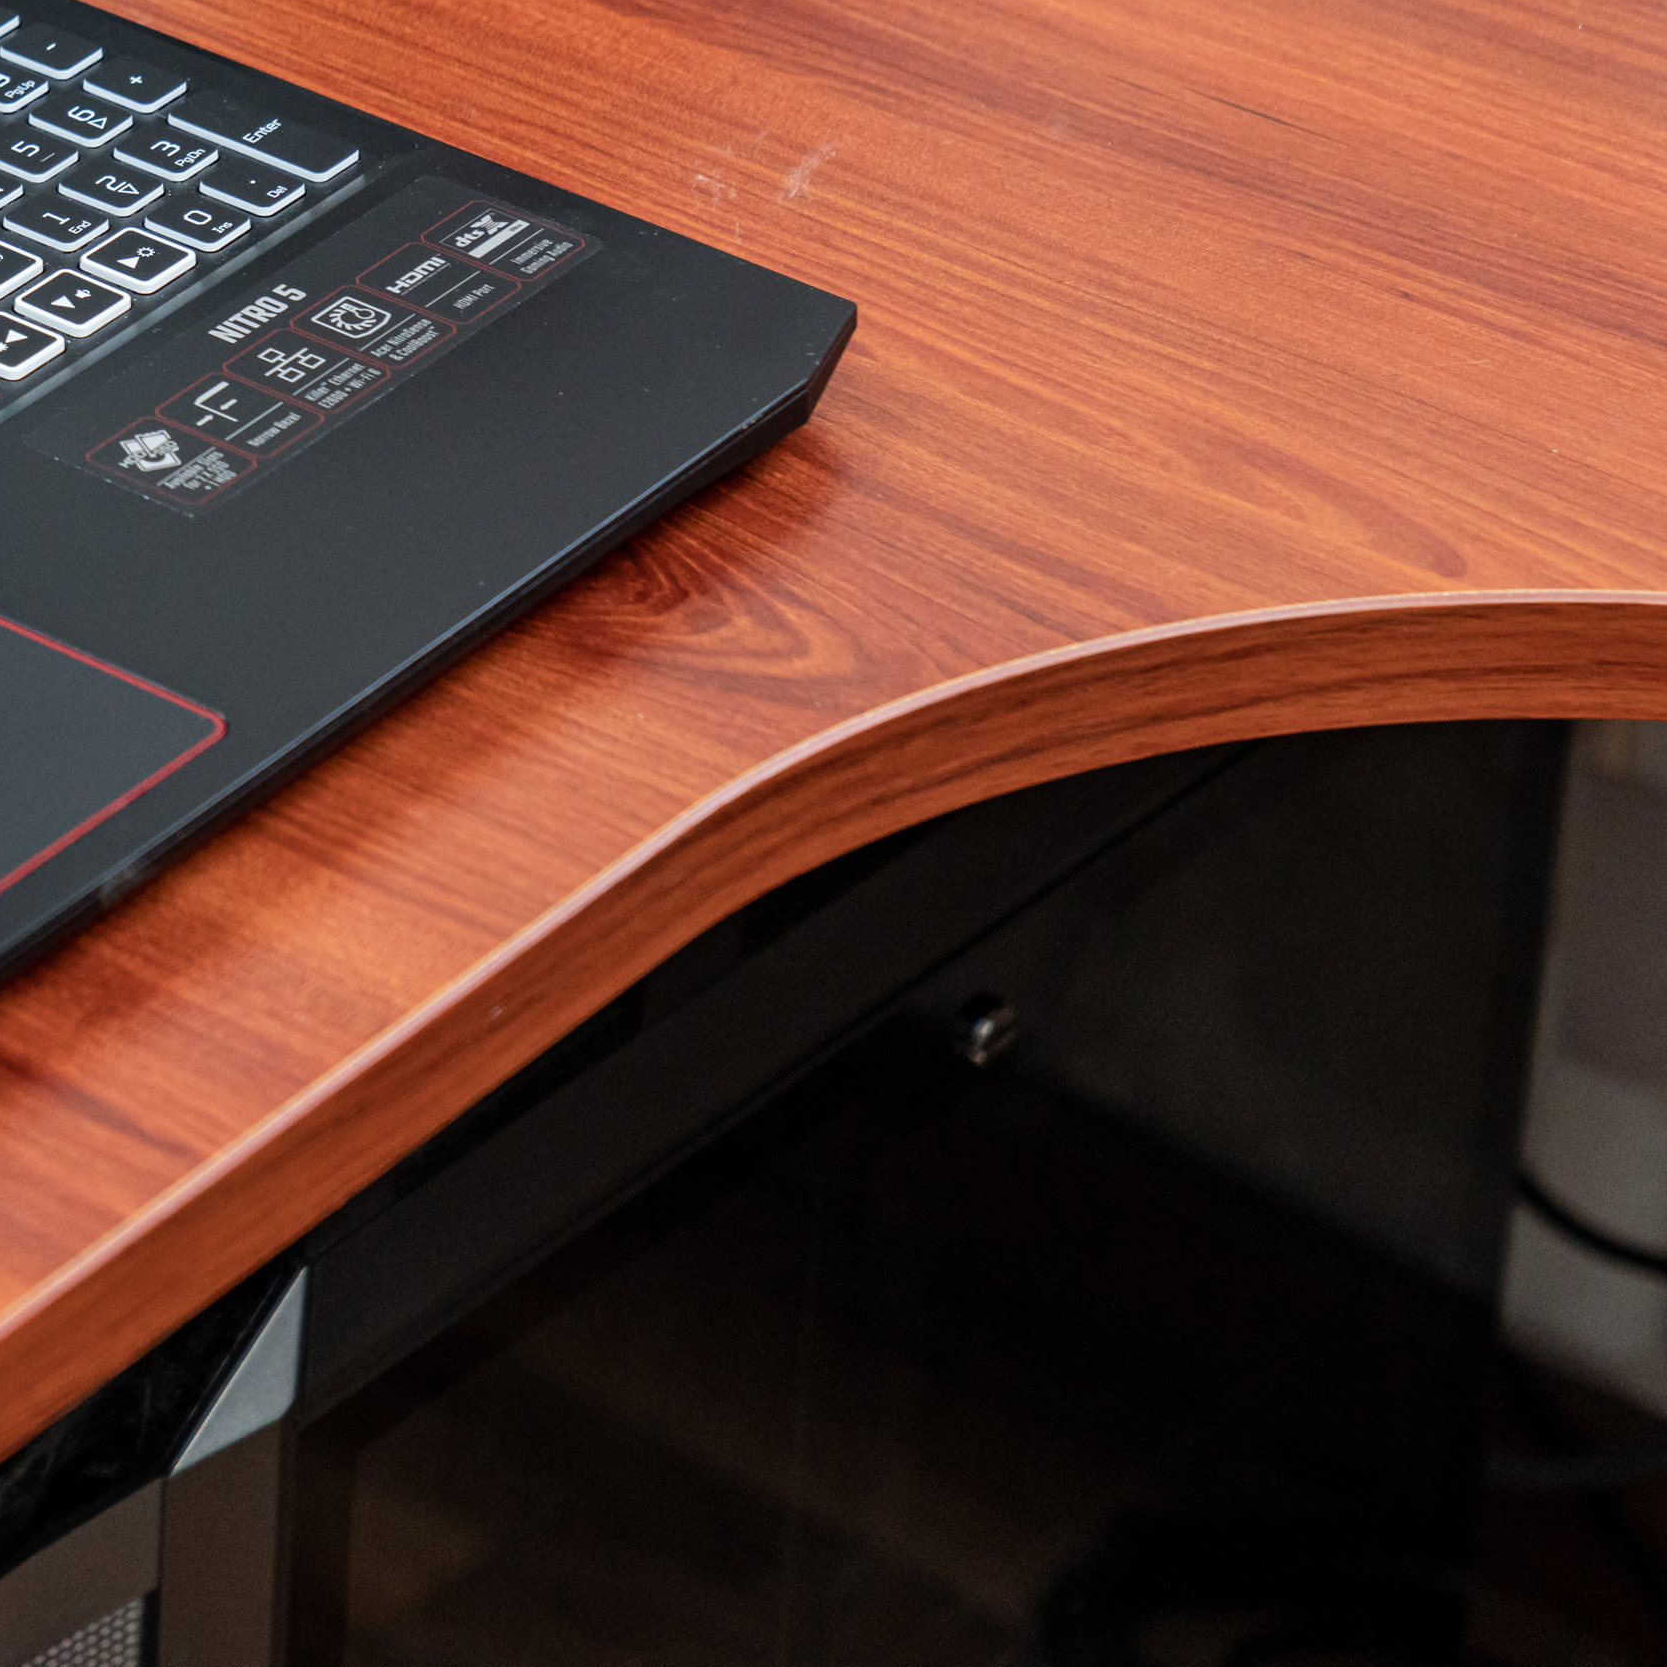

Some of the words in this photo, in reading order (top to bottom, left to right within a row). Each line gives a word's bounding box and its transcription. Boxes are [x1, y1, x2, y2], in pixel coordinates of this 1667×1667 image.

[3, 79, 37, 100] PgUp
[66, 105, 97, 123] 6
[241, 117, 283, 145] Enter
[9, 139, 41, 159] 5
[149, 139, 182, 158] 3
[173, 147, 207, 168] PgDn
[94, 174, 128, 193] 2
[265, 184, 289, 200] Del
[41, 211, 72, 226] 1
[67, 219, 93, 235] End
[182, 208, 214, 226] 0
[210, 220, 234, 235] Ins
[510, 238, 553, 265] Immersive
[520, 251, 556, 275] Gaming
[548, 241, 573, 262] Audio
[452, 292, 478, 311] HDMI
[475, 283, 495, 299] Port
[207, 294, 276, 345] NITRO
[276, 283, 307, 312] 5
[370, 342, 394, 359] Acer
[390, 318, 433, 348] NitroSense
[328, 362, 366, 386] Ethernet
[246, 424, 279, 448] Narrow
[273, 411, 303, 431] Bezel
